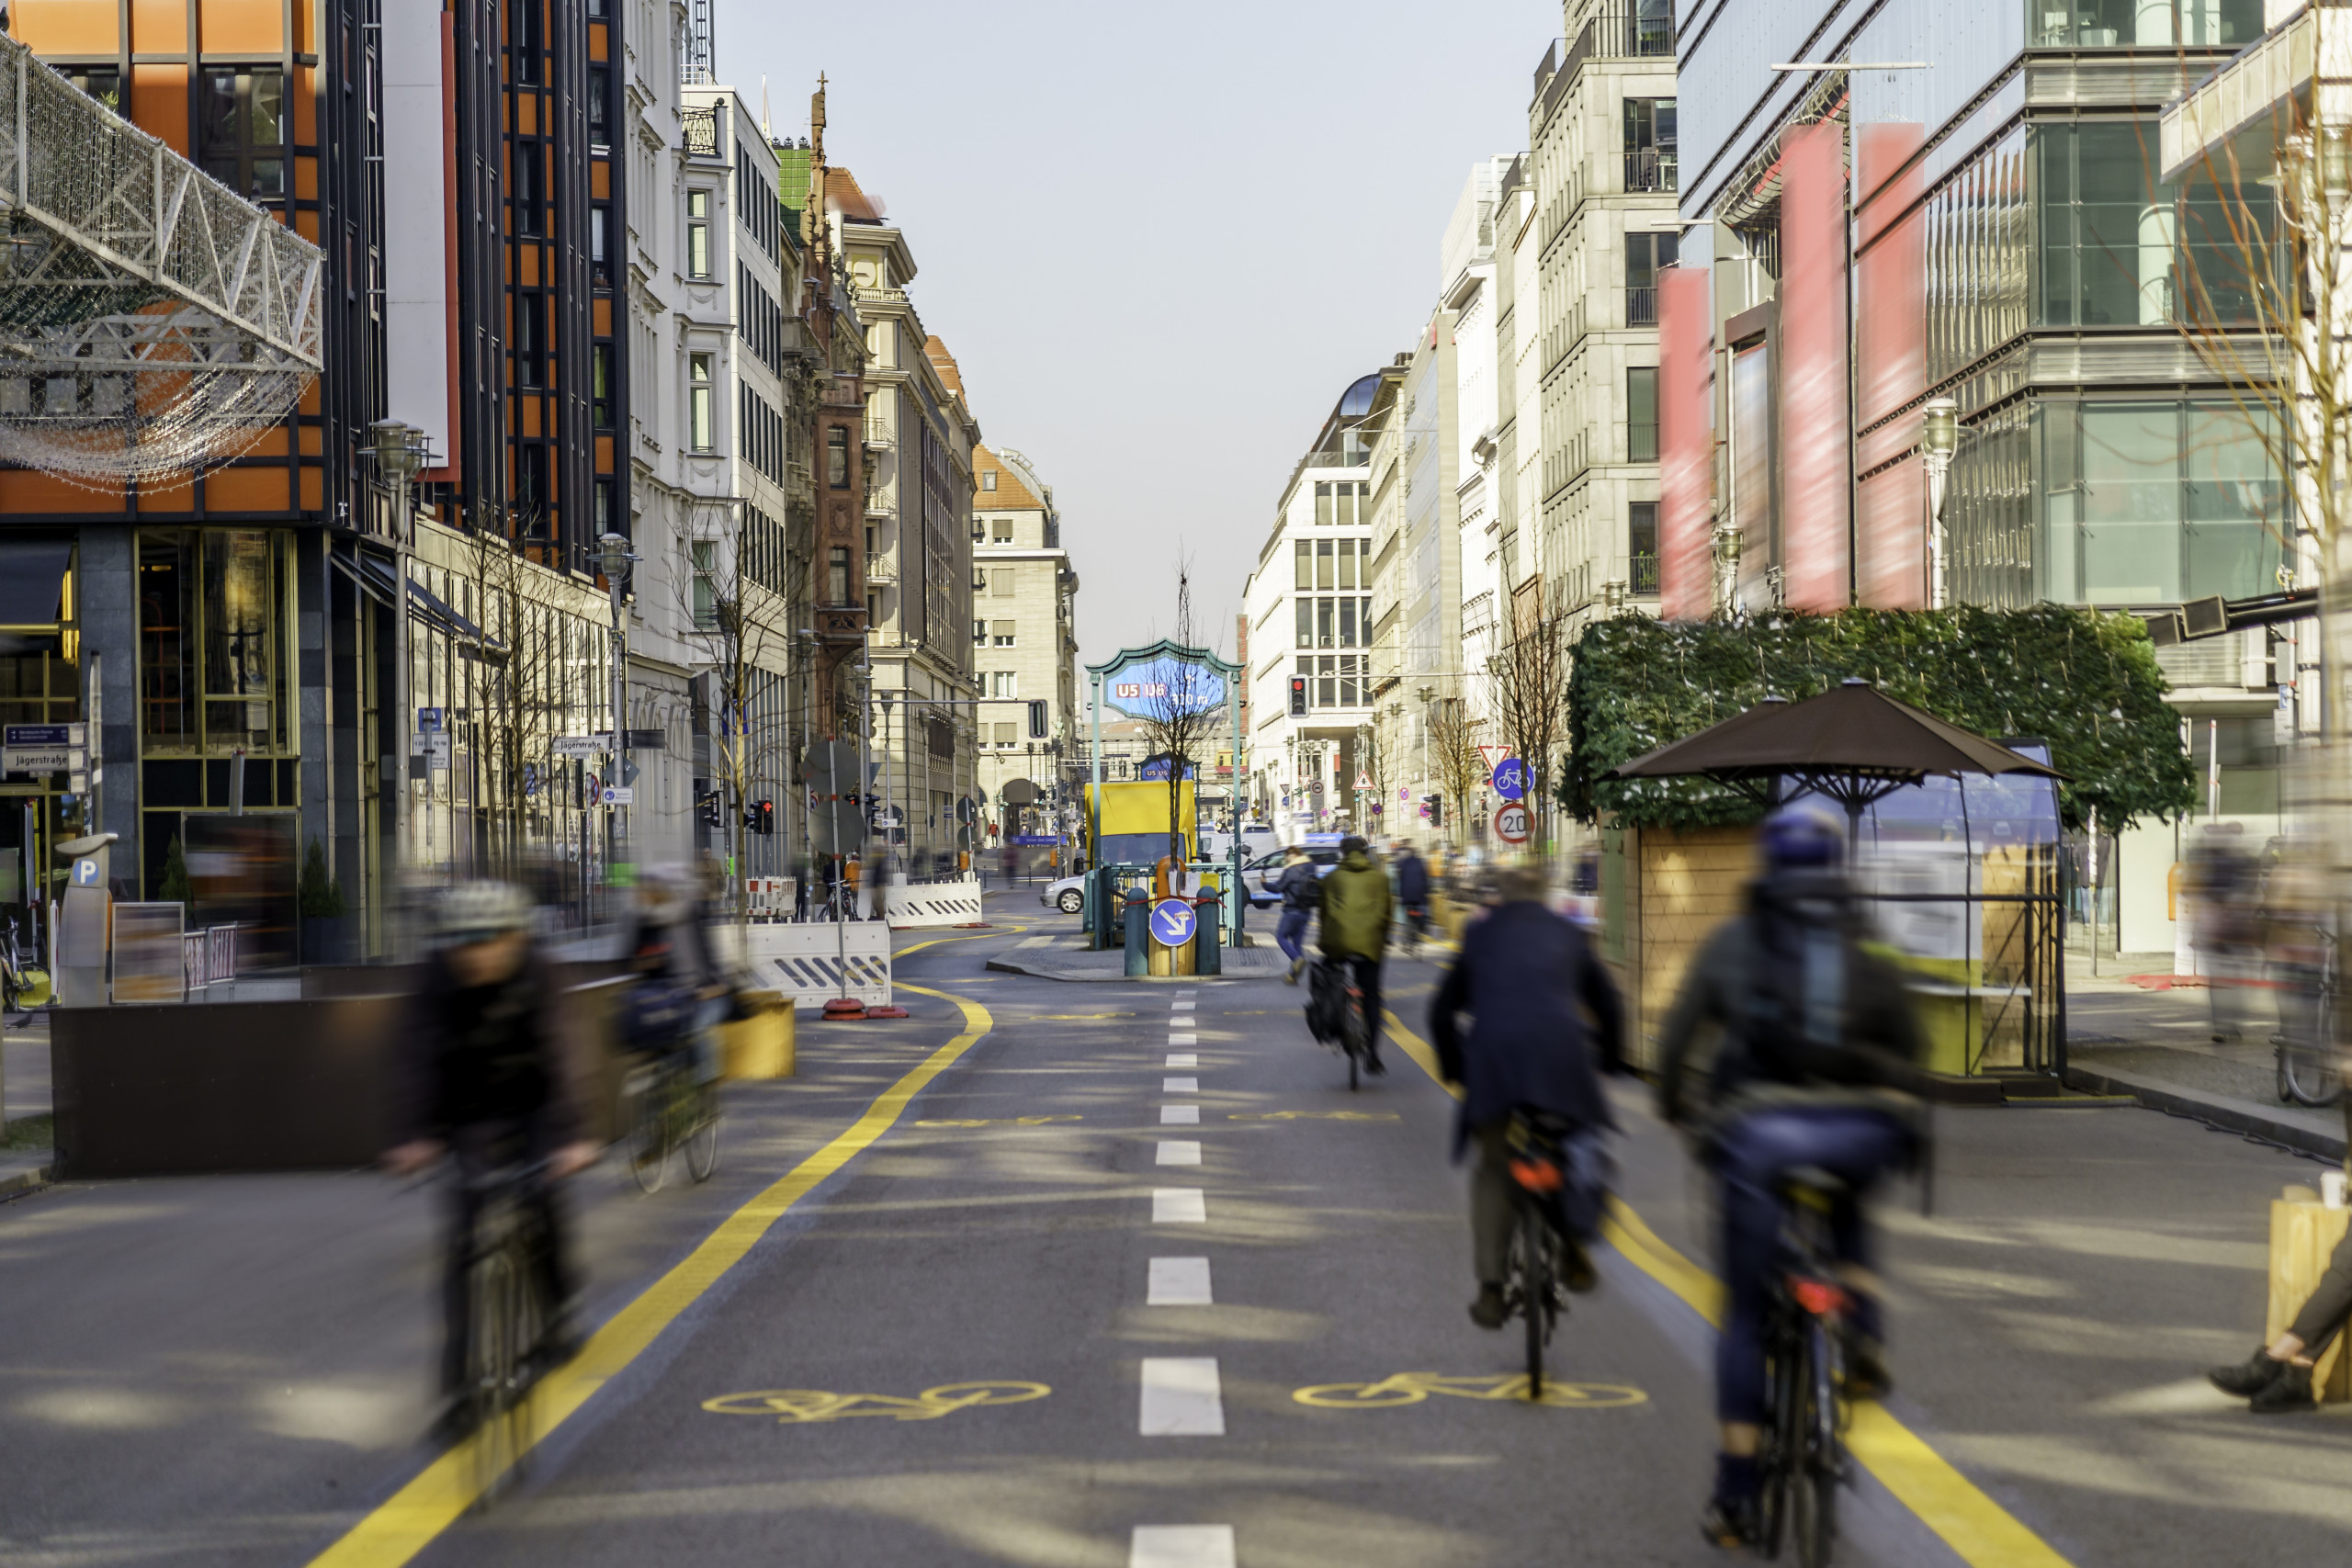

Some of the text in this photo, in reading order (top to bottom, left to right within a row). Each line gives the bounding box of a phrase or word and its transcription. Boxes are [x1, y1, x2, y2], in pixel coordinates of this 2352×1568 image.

[1118, 684, 1165, 697] U5 U6
[1197, 695, 1208, 705] m
[560, 740, 601, 750] Jägerstraße
[16, 754, 67, 766] Jägerstraße
[1504, 815, 1527, 833] 20
[80, 861, 96, 884] P
